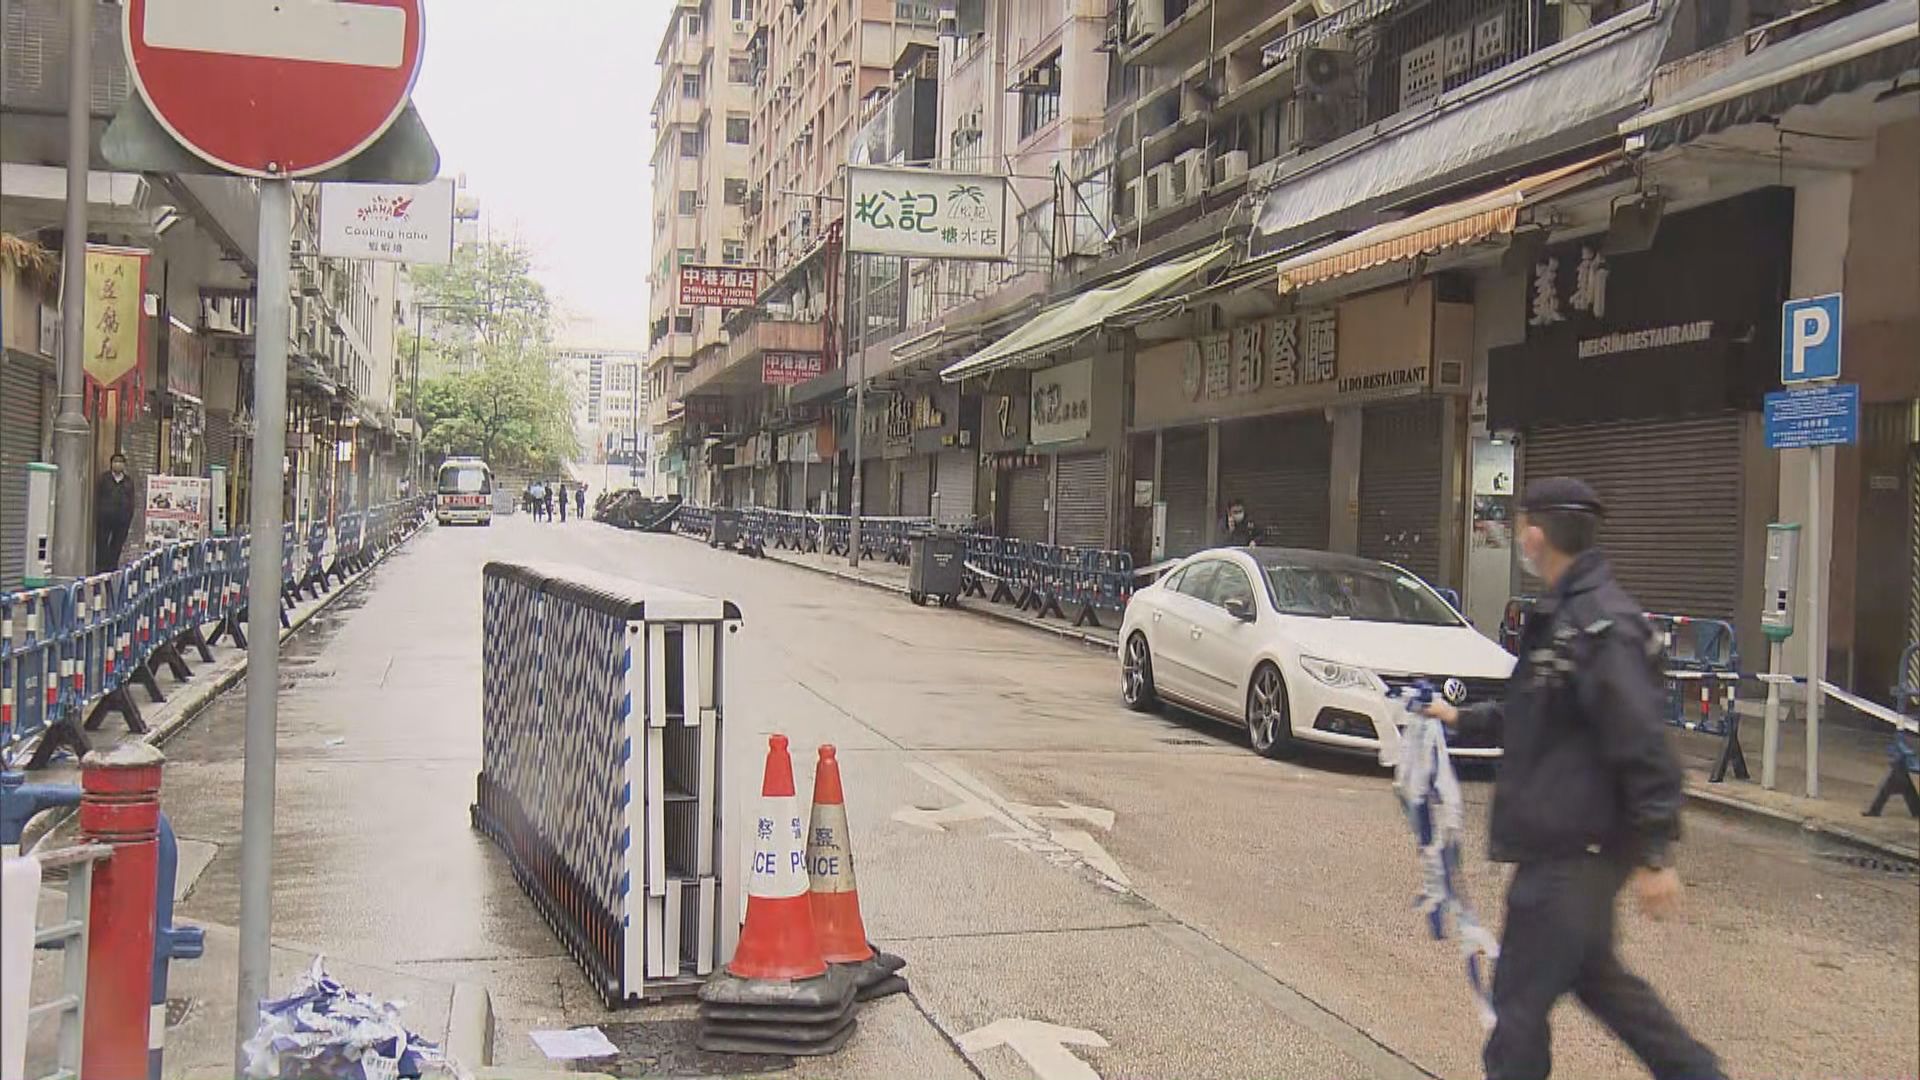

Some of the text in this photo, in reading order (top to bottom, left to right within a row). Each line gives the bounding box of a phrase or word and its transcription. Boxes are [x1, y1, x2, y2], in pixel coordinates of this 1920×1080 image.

[854, 190, 938, 233] 松記
[941, 226, 997, 246] 糖水店
[682, 267, 755, 288] 中港酒店
[729, 289, 754, 298] HOTEL
[1626, 320, 1714, 350] RESTAURANT
[1792, 306, 1830, 373] P
[1338, 366, 1427, 393] LIDO RESTAURANT
